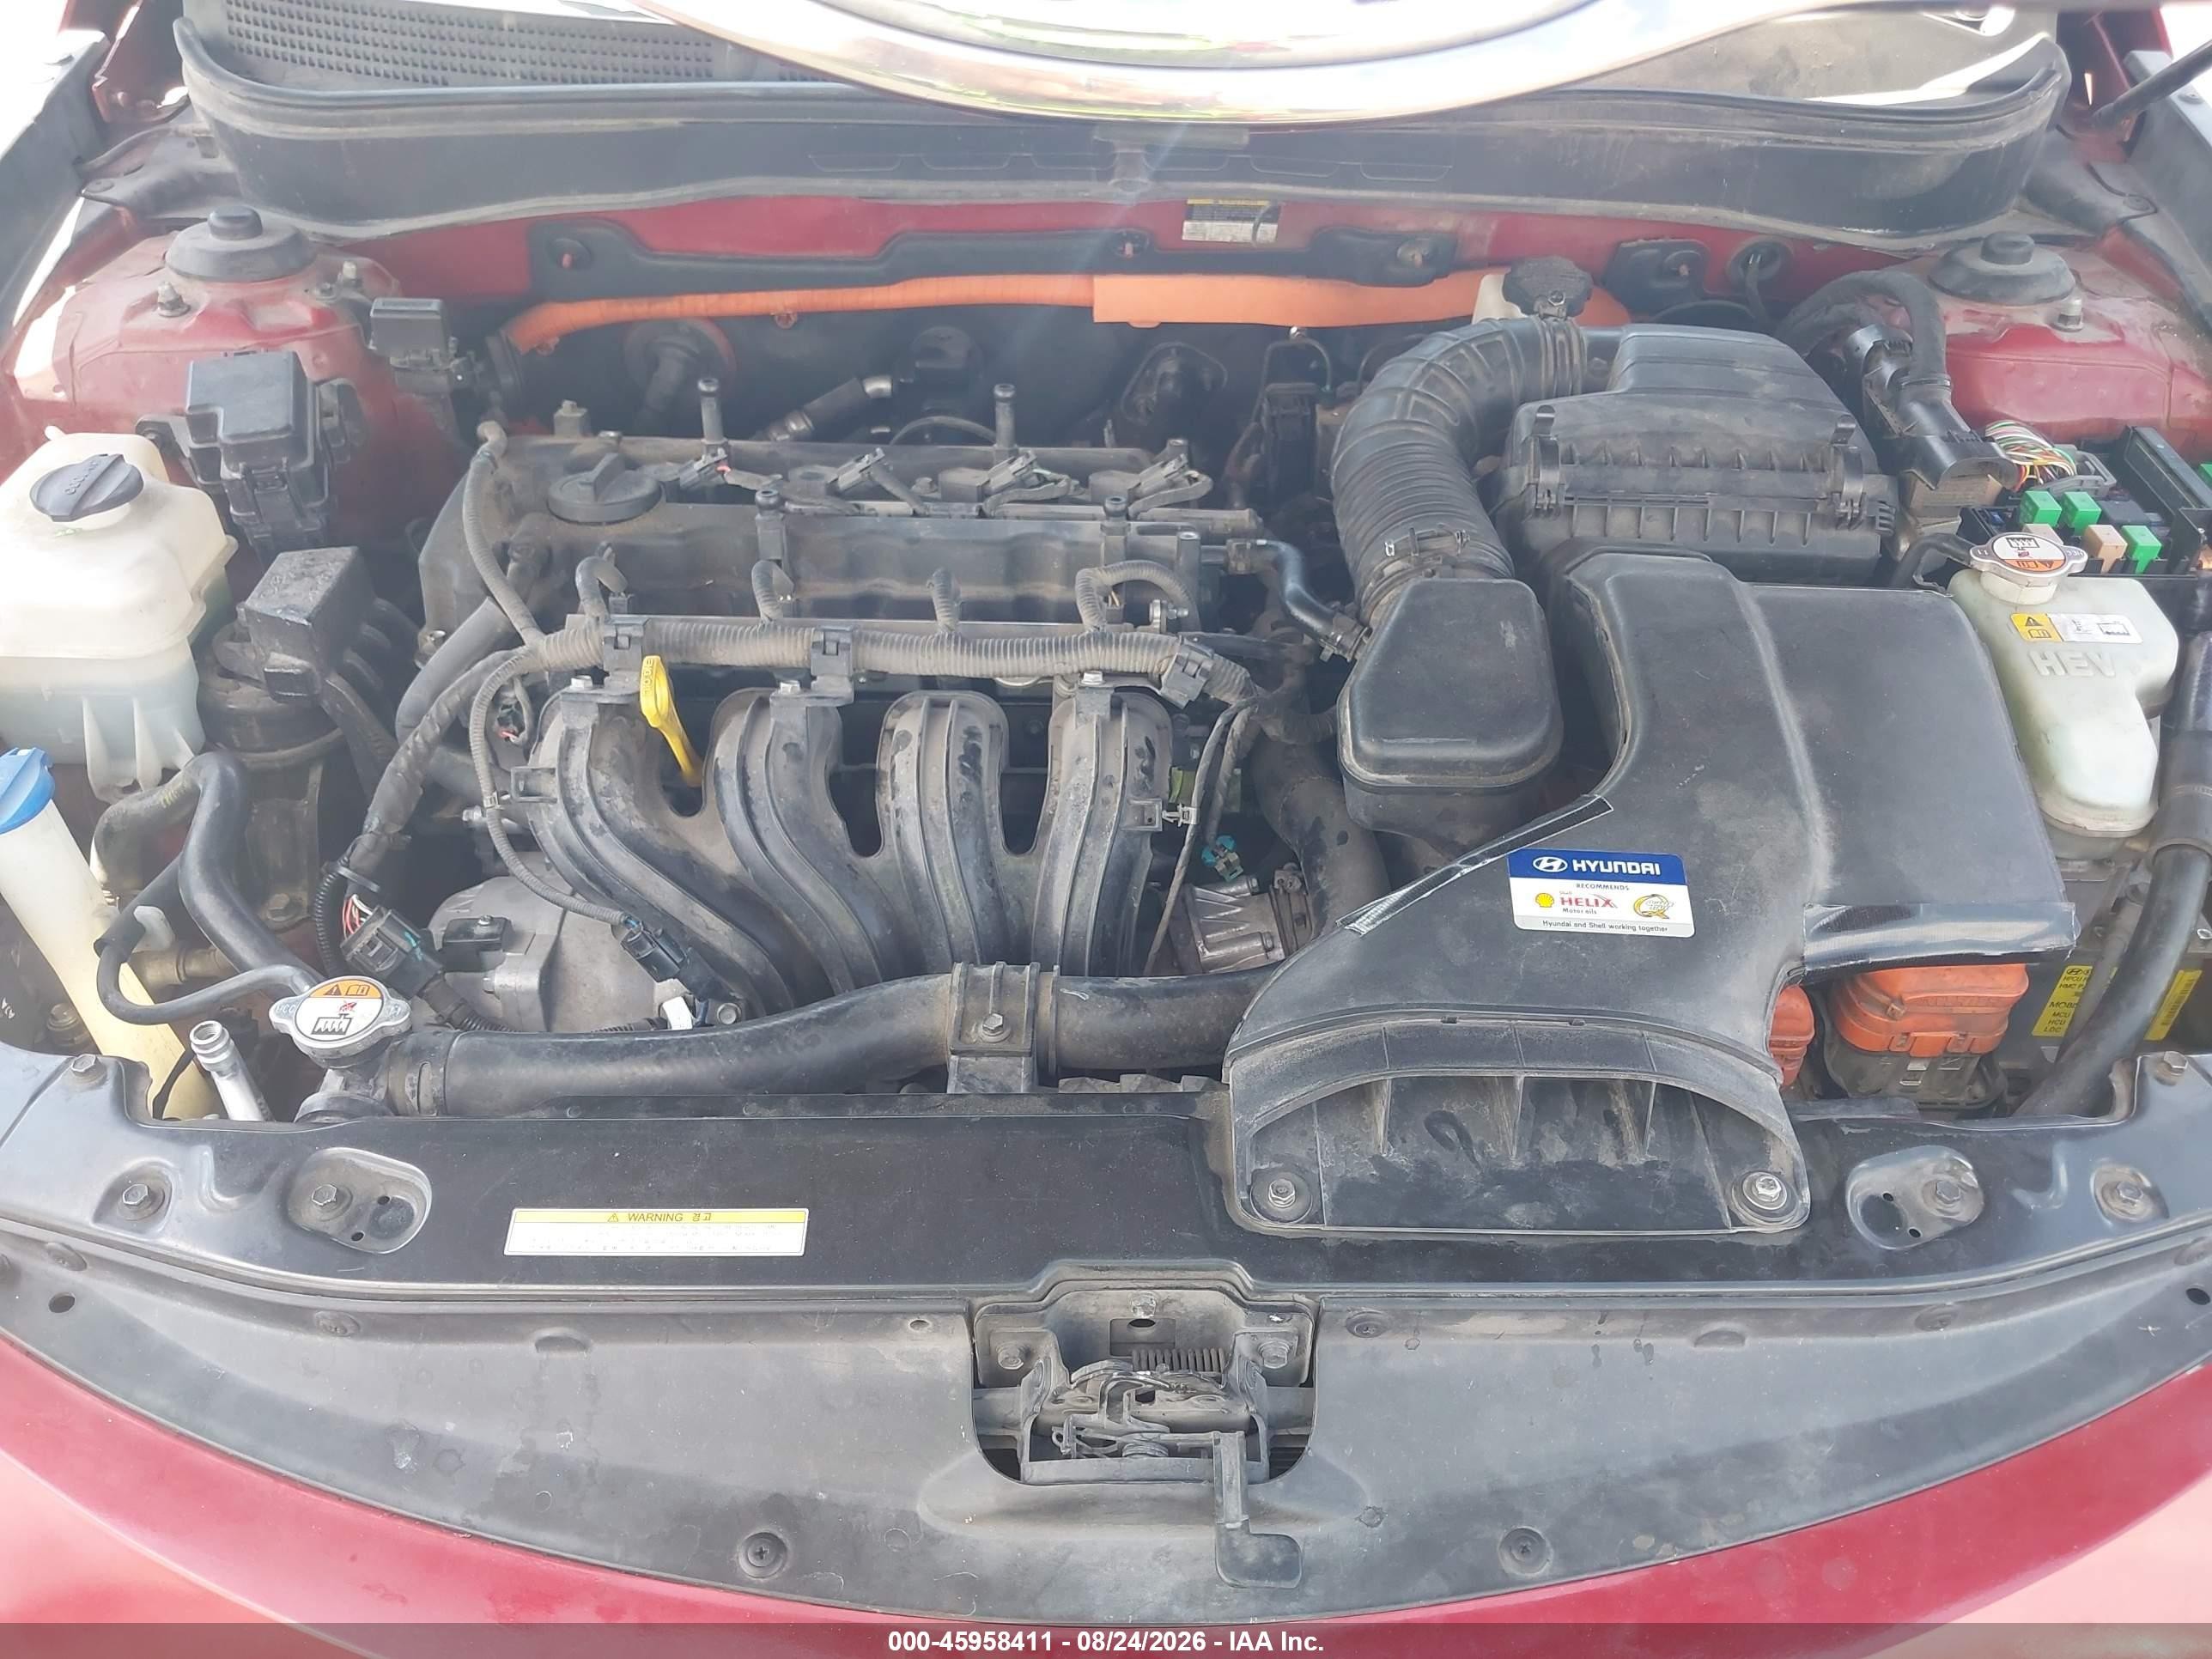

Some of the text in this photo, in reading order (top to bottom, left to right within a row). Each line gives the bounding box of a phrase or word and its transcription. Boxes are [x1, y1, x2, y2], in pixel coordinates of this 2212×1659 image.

[2027, 650, 2115, 678] HEV
[1571, 859, 1662, 876] HYUNDAI
[1576, 883, 1630, 891] RECOMMENDS
[1560, 896, 1614, 908] HELIX
[1542, 920, 1571, 928] Hyundai
[1638, 925, 1668, 933] together
[628, 1212, 684, 1222] WARNING
